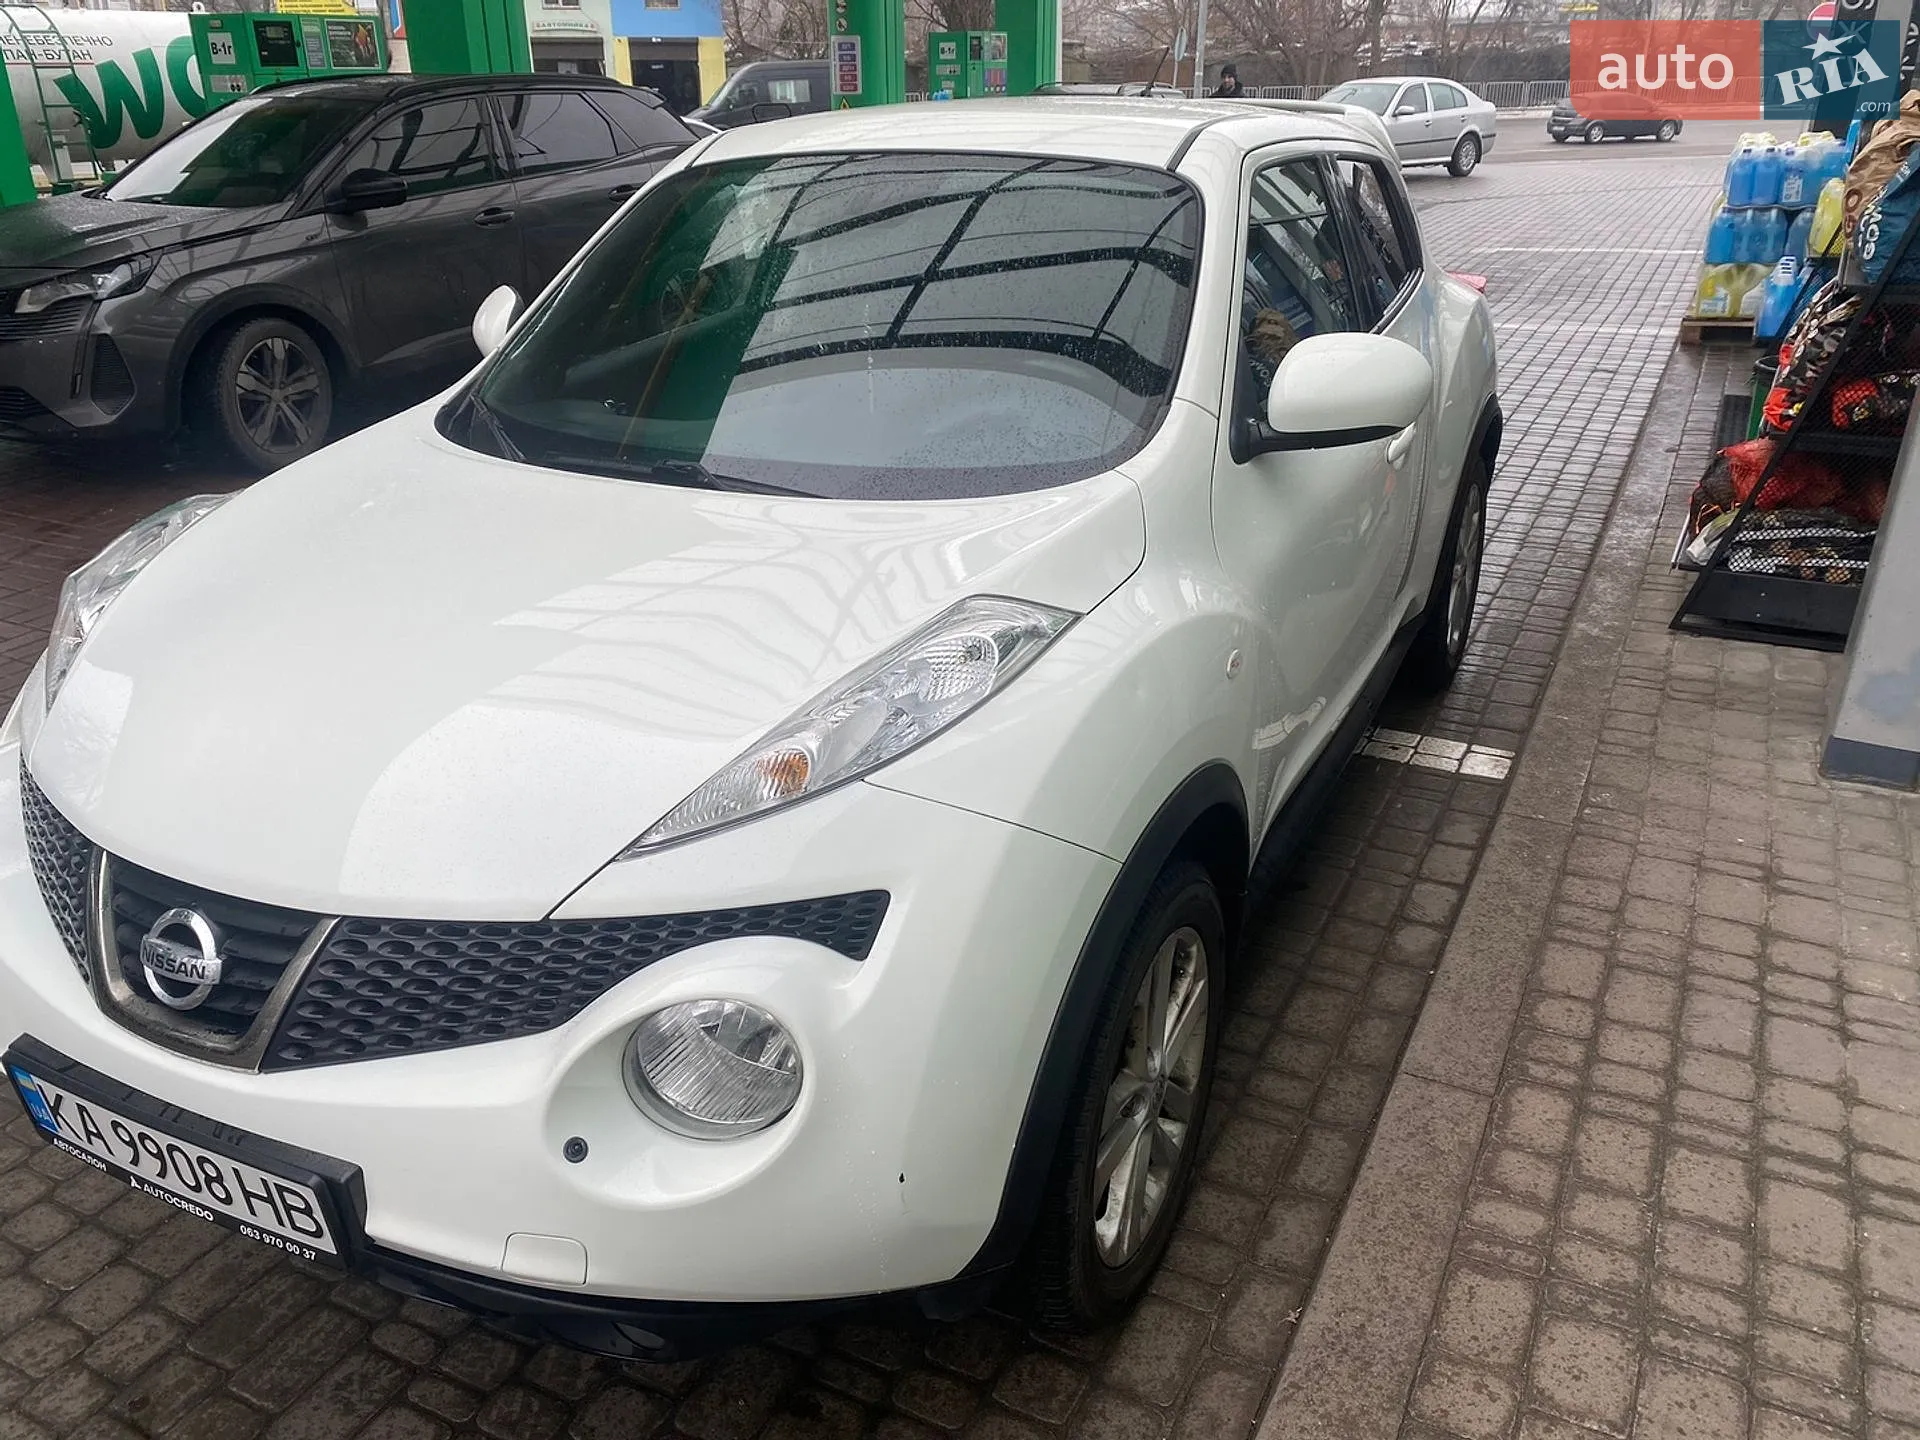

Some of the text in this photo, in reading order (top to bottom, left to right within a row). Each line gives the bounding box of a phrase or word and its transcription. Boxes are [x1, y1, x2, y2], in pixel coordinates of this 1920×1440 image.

[142, 942, 206, 980] NISSAN
[143, 1183, 214, 1222] AUTOCREDO
[262, 1233, 283, 1249] 970
[302, 1248, 316, 1261] 37
